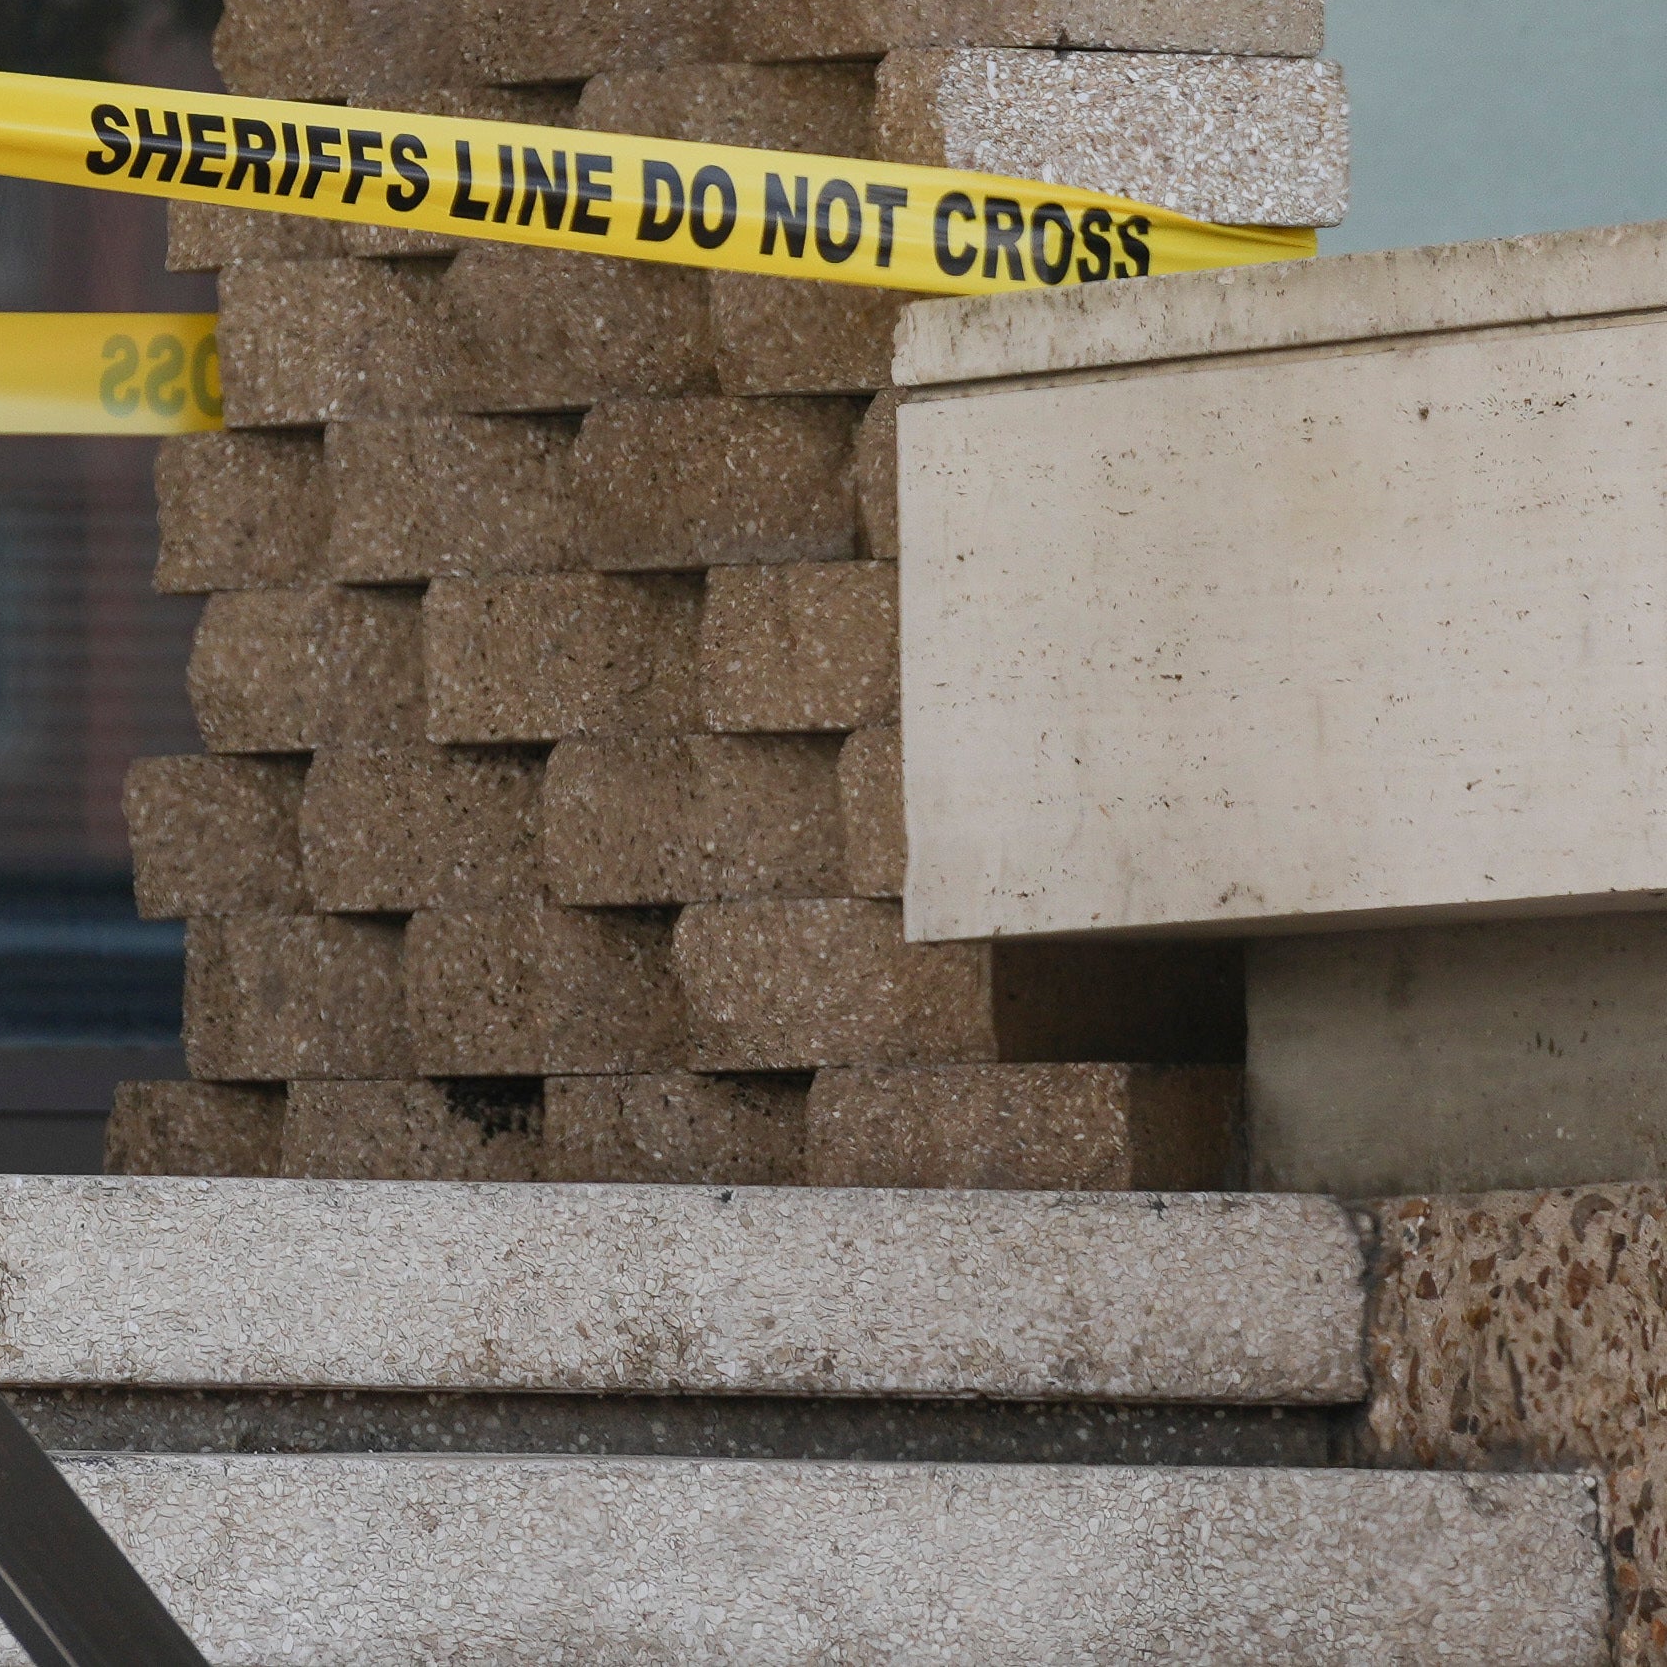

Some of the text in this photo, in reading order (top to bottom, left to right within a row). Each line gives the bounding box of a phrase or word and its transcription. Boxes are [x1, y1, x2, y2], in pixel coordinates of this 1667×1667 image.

[85, 102, 1151, 285] SHERIFFS LINE DO NOT CROSS
